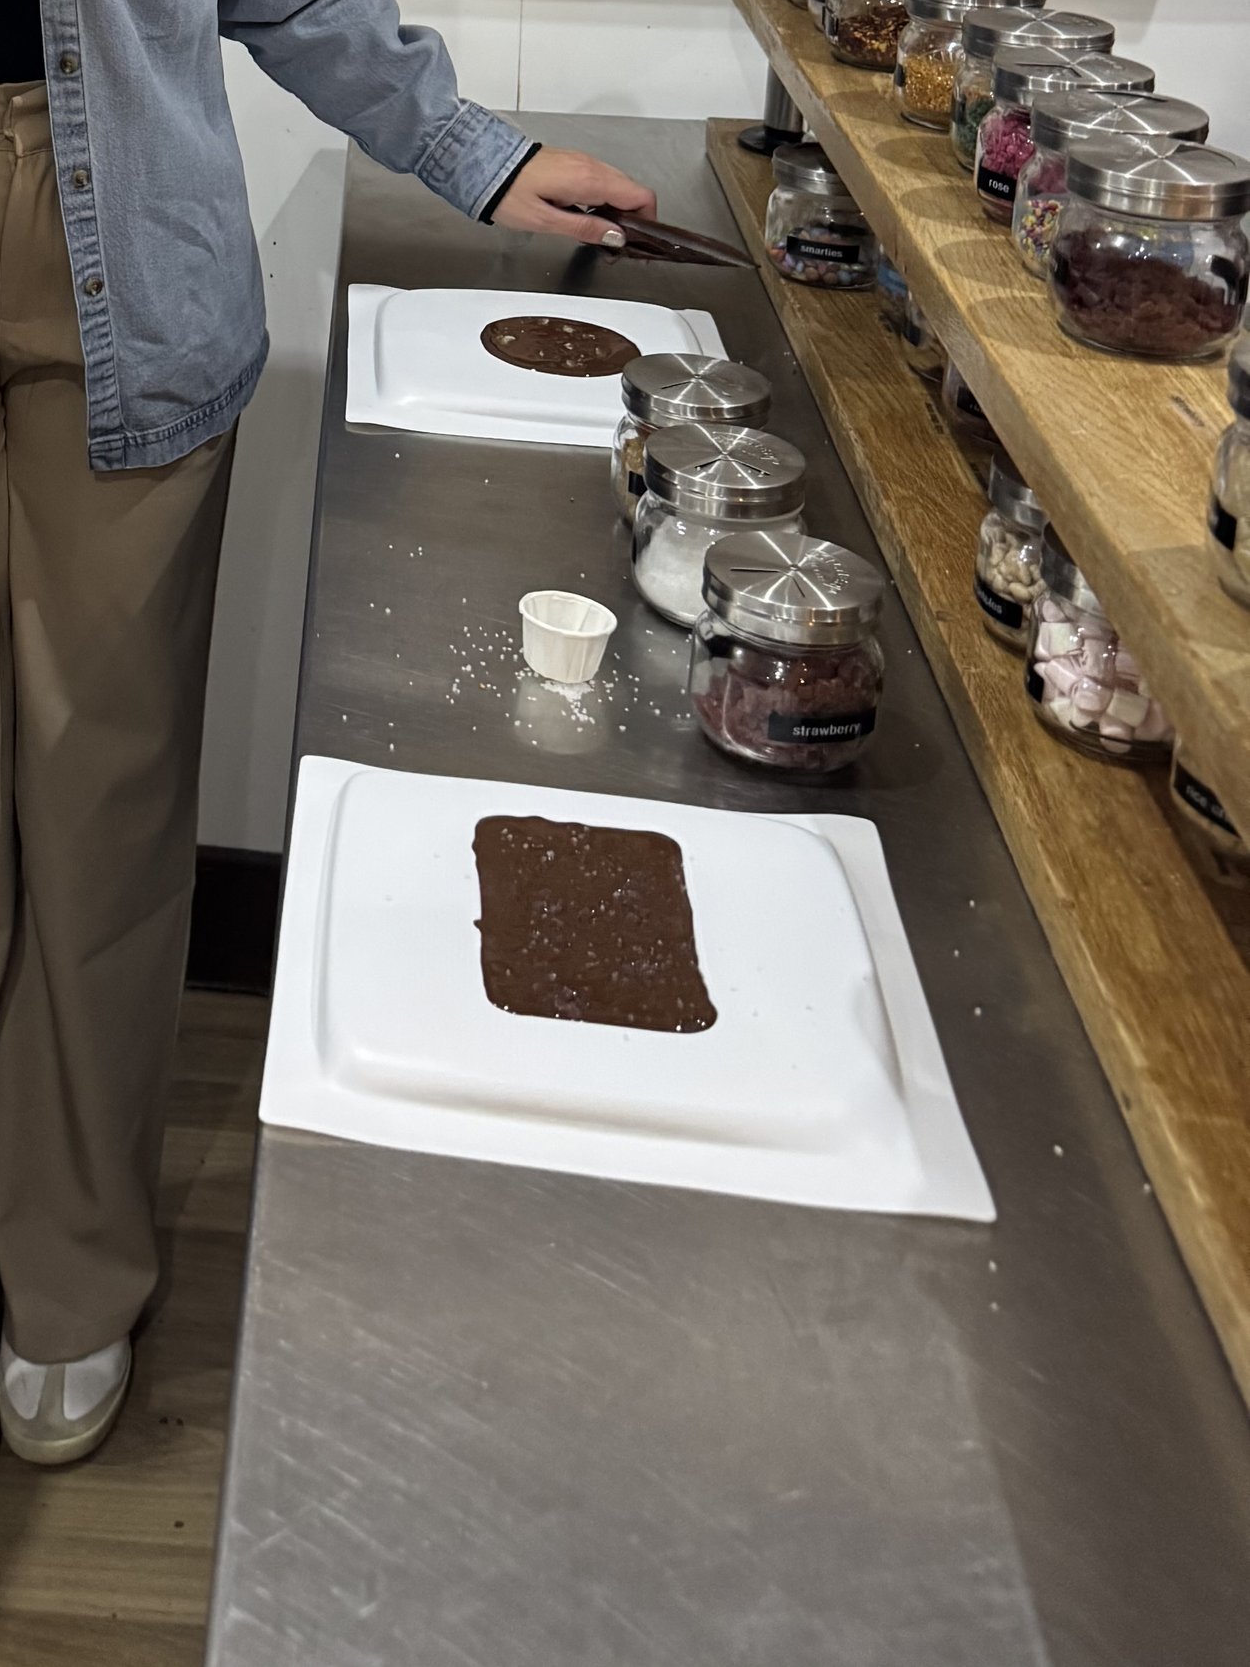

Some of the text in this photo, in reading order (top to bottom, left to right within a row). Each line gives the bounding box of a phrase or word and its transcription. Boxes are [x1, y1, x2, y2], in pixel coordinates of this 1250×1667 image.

[988, 178, 1010, 194] rose
[800, 244, 843, 259] smarties
[792, 722, 862, 737] strawberry
